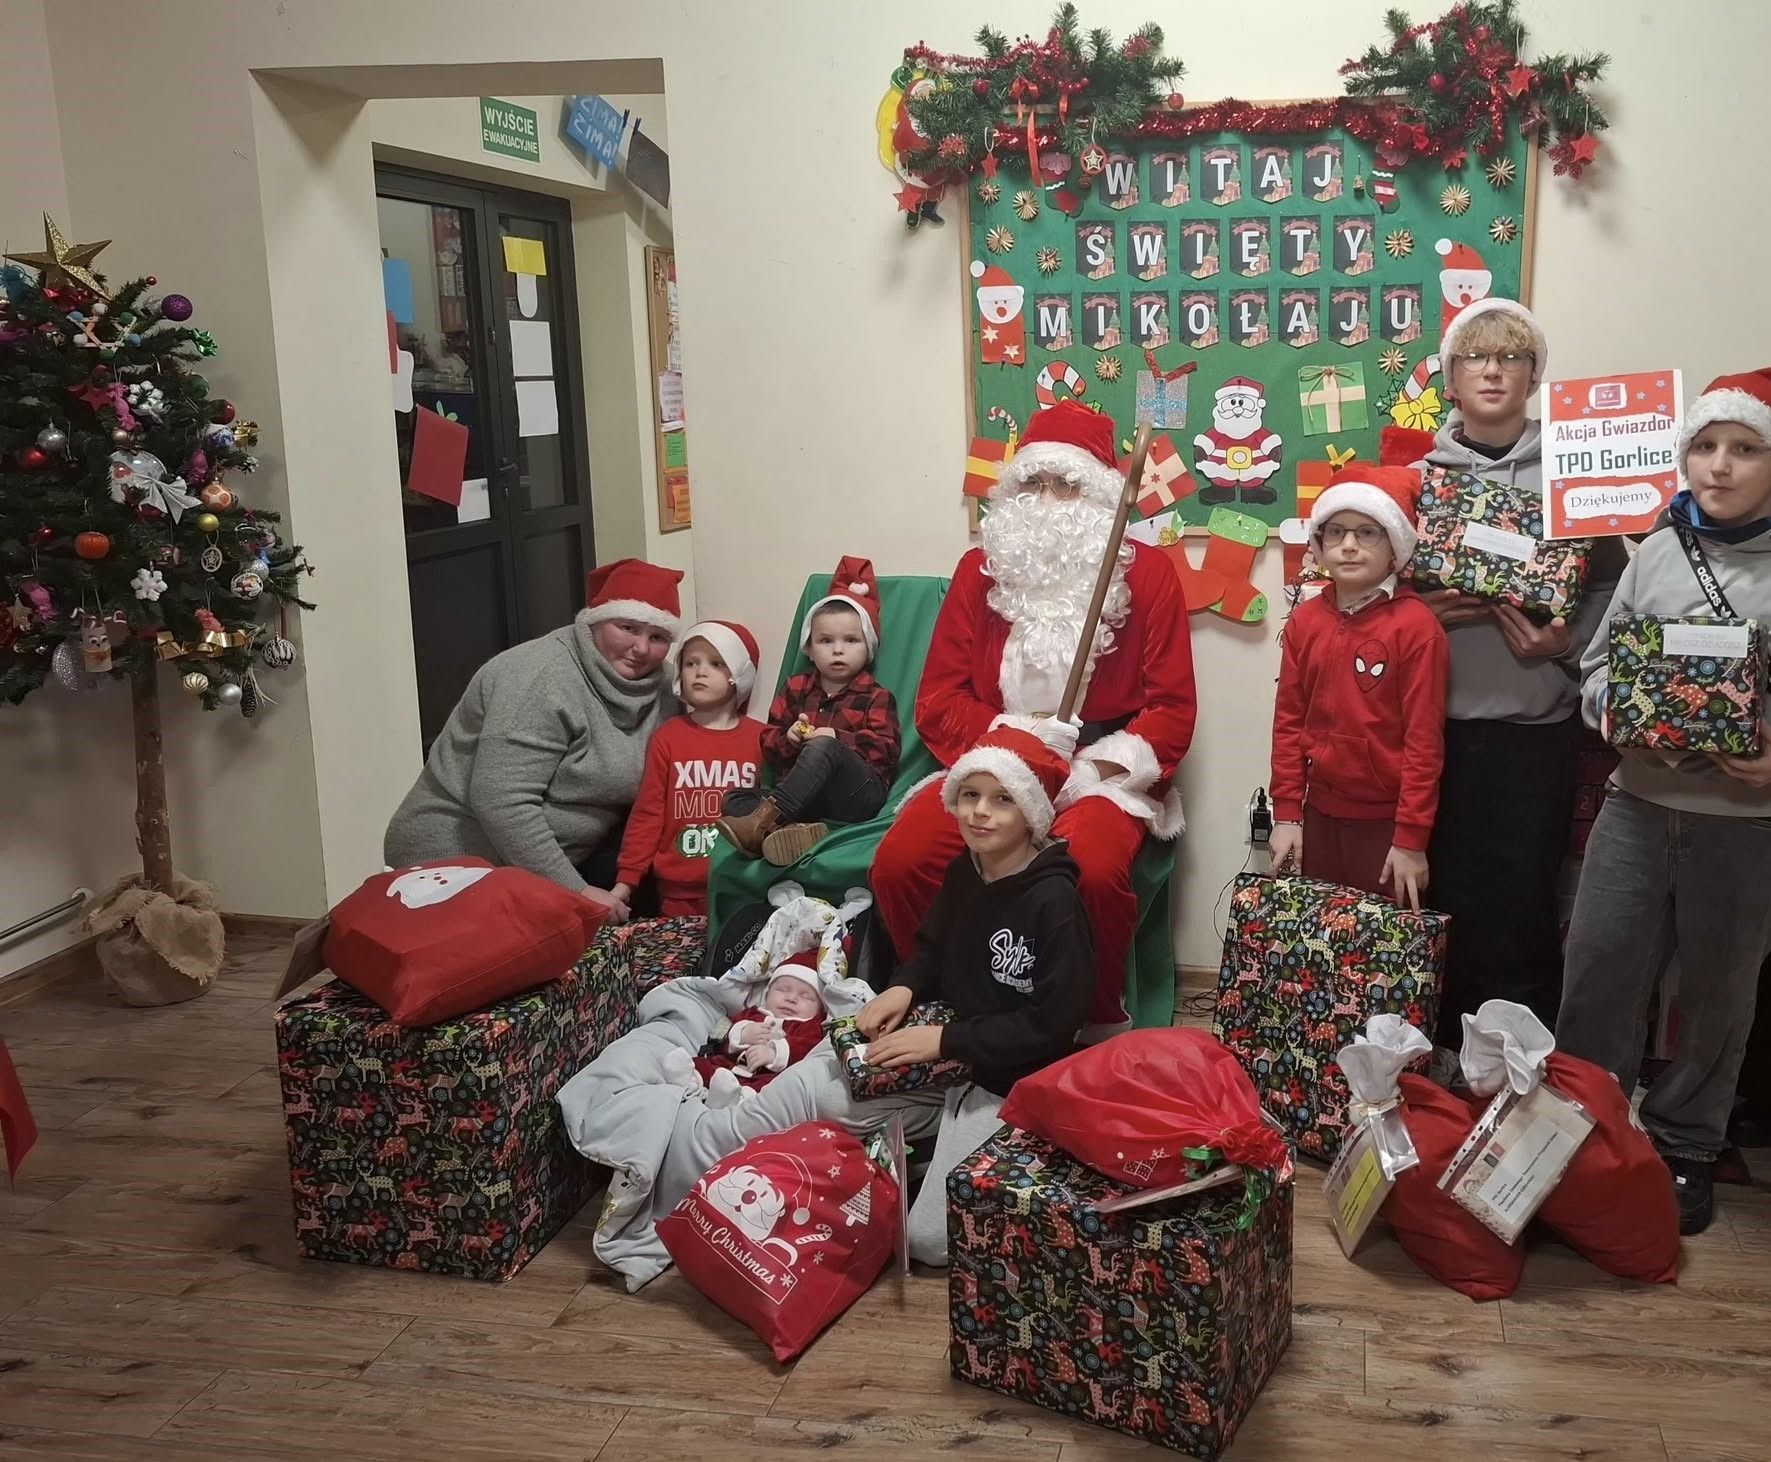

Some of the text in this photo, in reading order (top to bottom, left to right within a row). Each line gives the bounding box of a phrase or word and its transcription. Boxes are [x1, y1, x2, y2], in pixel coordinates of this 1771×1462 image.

[484, 106, 535, 136] WYJŚCIE
[483, 128, 539, 154] EWAKUACYJNE
[1105, 153, 1333, 195] WITAJ
[1086, 226, 1365, 272] ŚWIĘTY
[1040, 298, 1412, 338] MIKOŁAJU
[1555, 415, 1676, 442] Akcja Gwiazdor
[1555, 446, 1673, 475] TPD Gorlice
[1570, 491, 1652, 509] Dziękujemy
[1696, 566, 1722, 607] adidas
[674, 760, 757, 789] XMAS
[674, 789, 727, 819] MO
[674, 1198, 776, 1286] Merry Christmas
